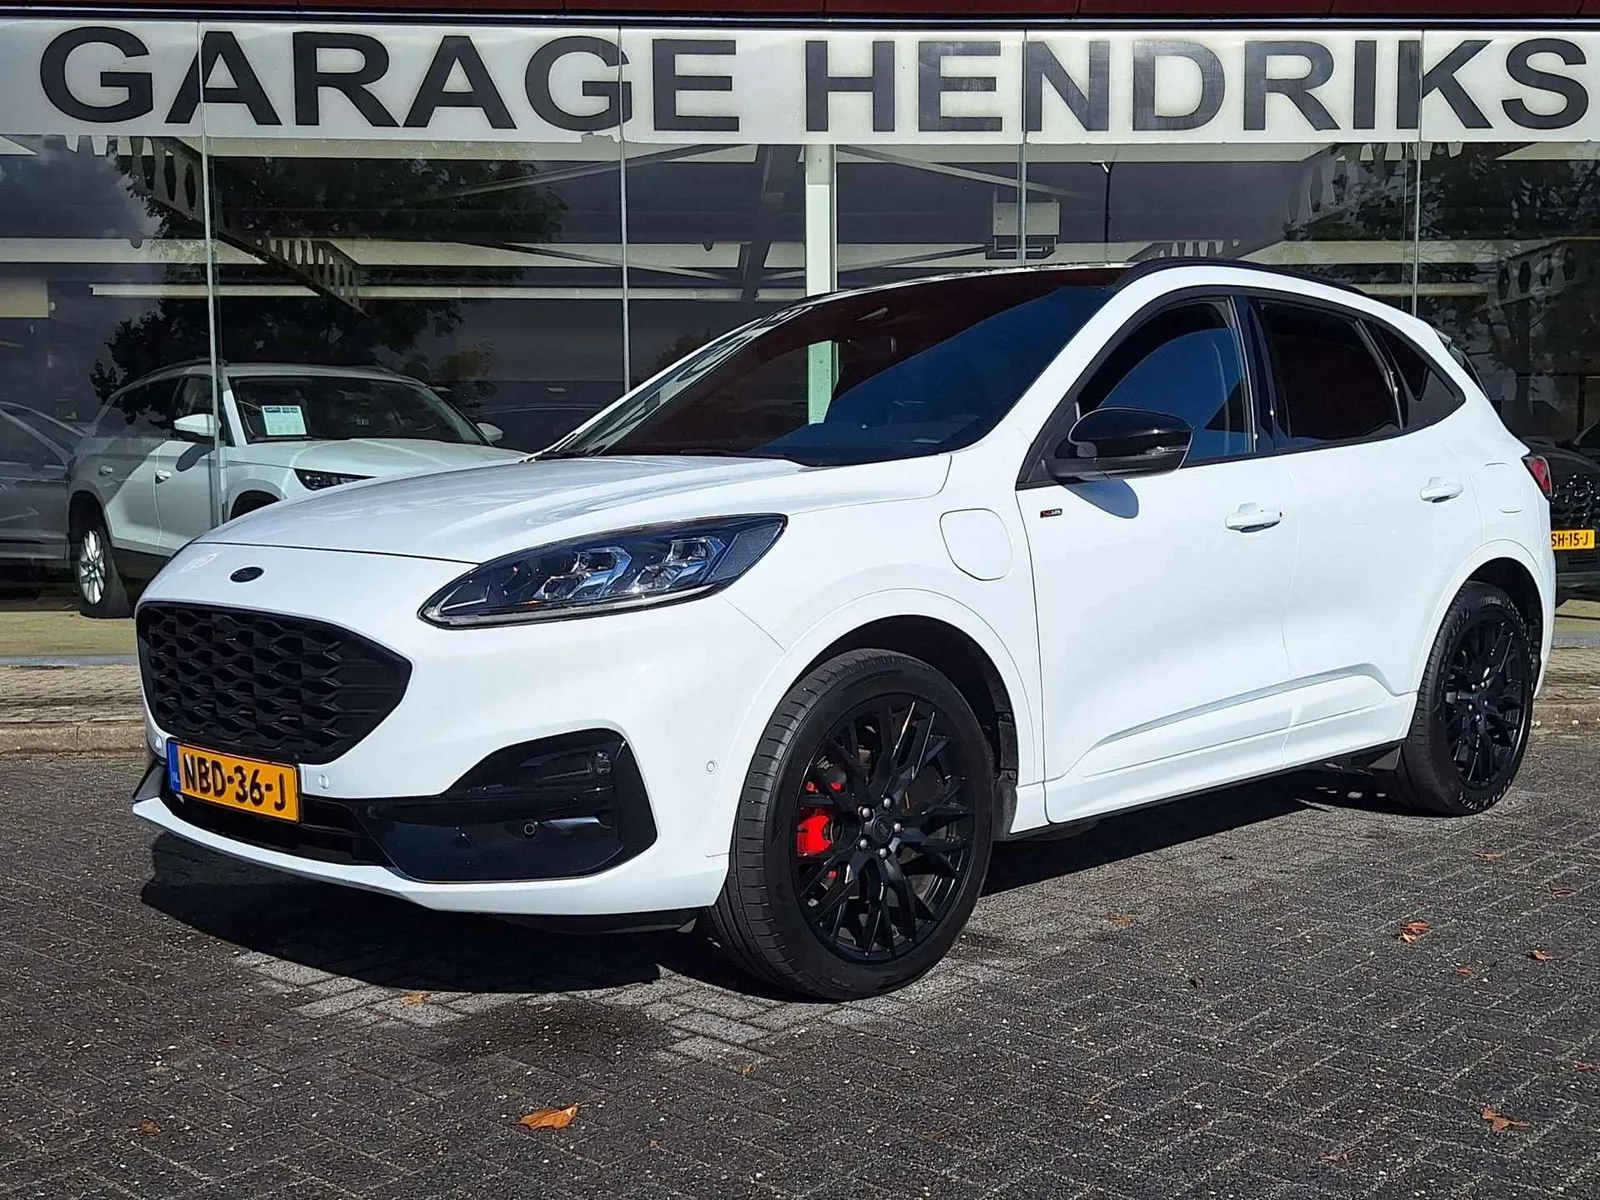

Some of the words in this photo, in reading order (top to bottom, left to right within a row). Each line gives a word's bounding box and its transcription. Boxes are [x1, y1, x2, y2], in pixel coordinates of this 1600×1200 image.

[40, 26, 740, 132] GARAGE
[804, 38, 1590, 132] HENDRIKS
[183, 752, 287, 811] NBD-36-J
